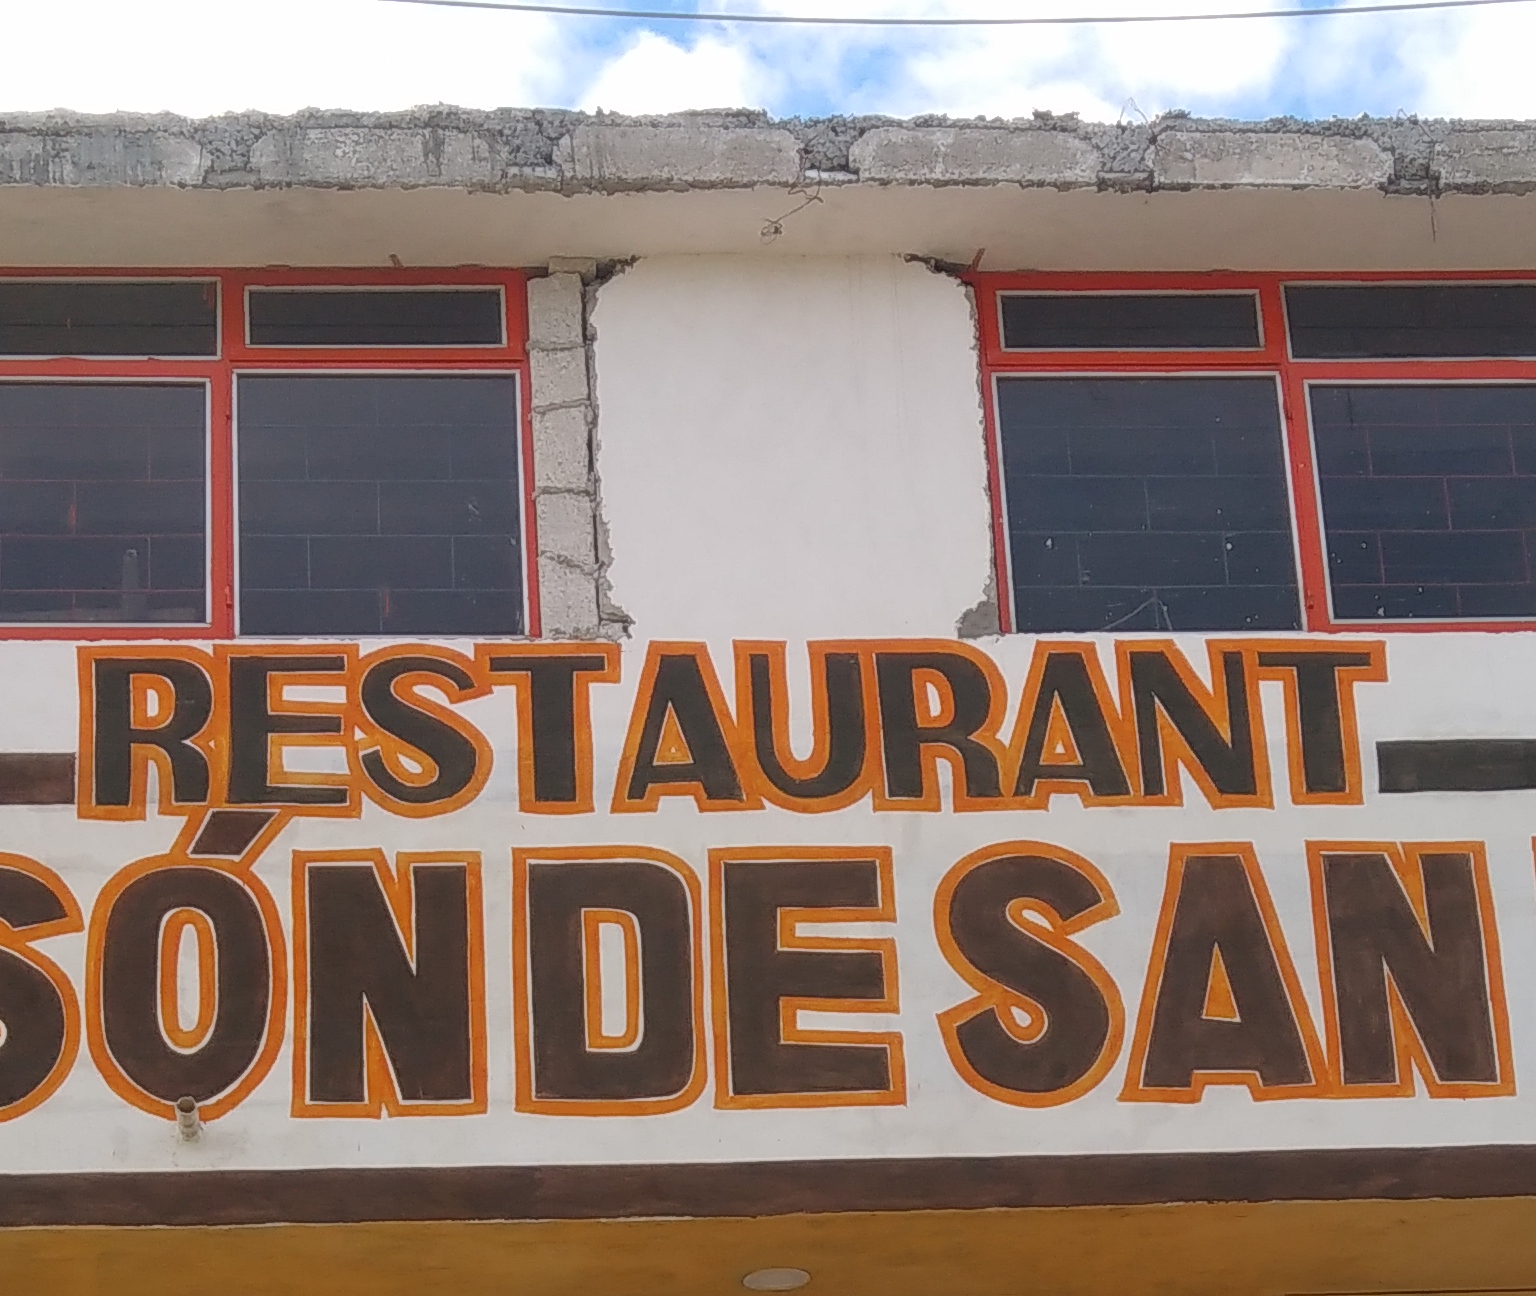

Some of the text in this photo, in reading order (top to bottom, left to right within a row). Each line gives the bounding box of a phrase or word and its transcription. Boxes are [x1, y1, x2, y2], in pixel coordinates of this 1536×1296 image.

[75, 639, 1387, 821] RESTAURANT
[511, 845, 907, 1115] DE
[934, 840, 1519, 1108] SAN
